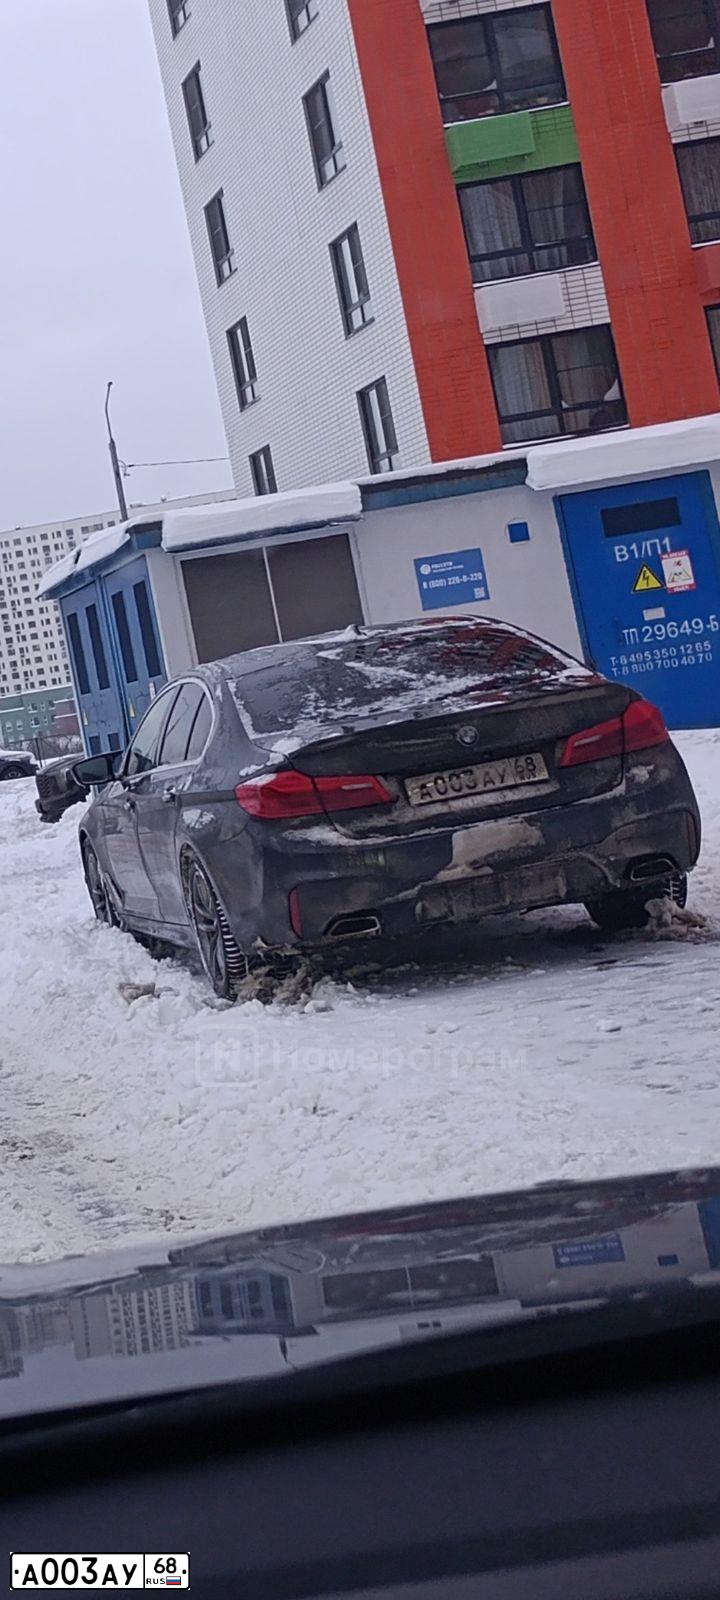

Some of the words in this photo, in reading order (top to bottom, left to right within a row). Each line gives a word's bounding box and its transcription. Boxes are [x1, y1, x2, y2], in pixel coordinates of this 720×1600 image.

[614, 536, 671, 562] В1/П1
[447, 573, 483, 585] 220-0-220
[622, 628, 639, 645] ТП
[629, 651, 652, 663] 495
[653, 647, 677, 659] 350
[631, 662, 654, 673] 800
[655, 658, 679, 669] 700
[514, 756, 537, 774] 68
